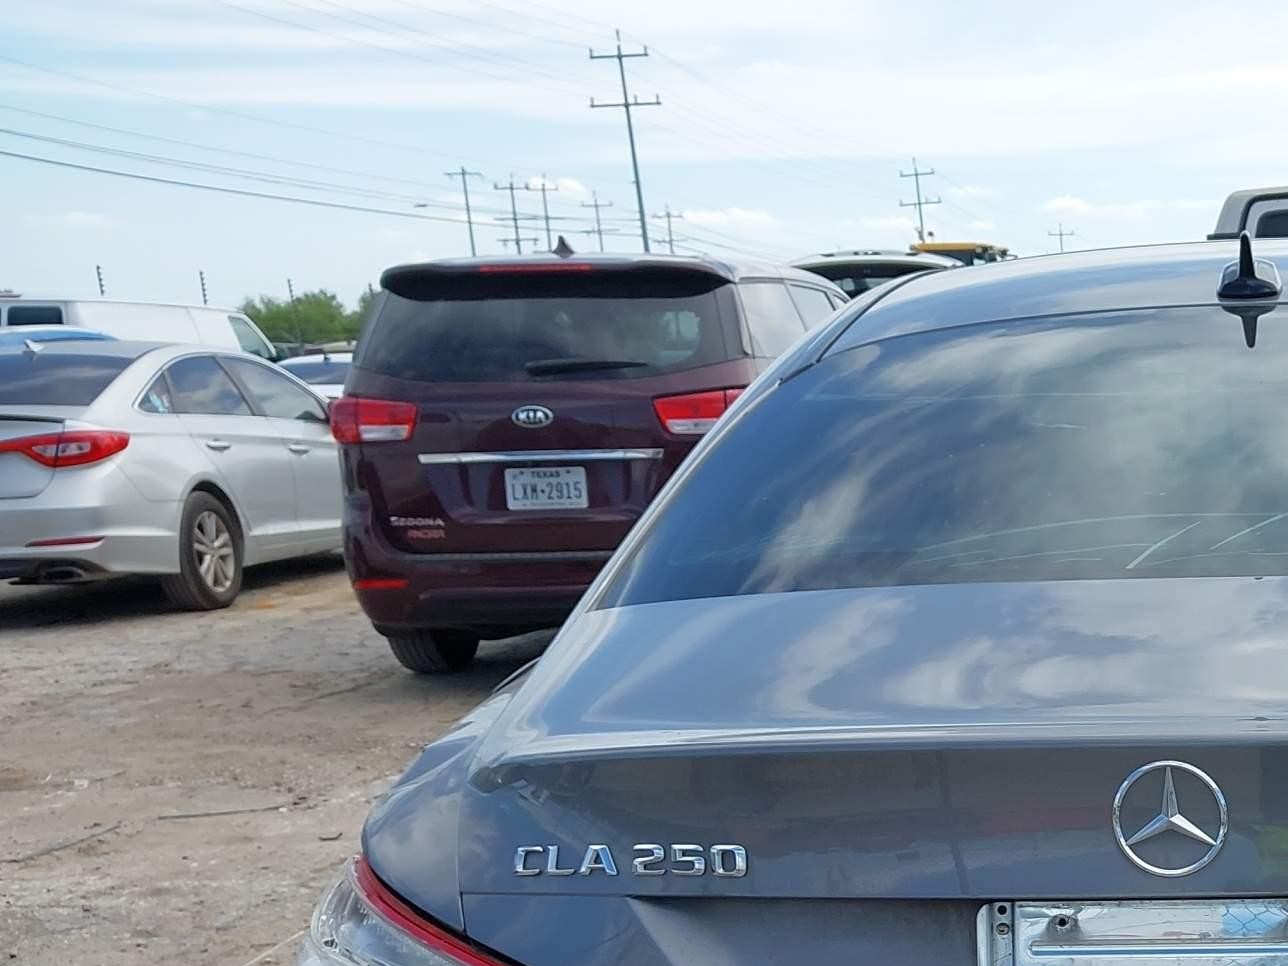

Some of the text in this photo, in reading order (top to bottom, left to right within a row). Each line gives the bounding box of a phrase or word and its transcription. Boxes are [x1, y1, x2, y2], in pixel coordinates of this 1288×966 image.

[530, 471, 560, 479] TEXAS
[515, 843, 749, 878] CLA 250
